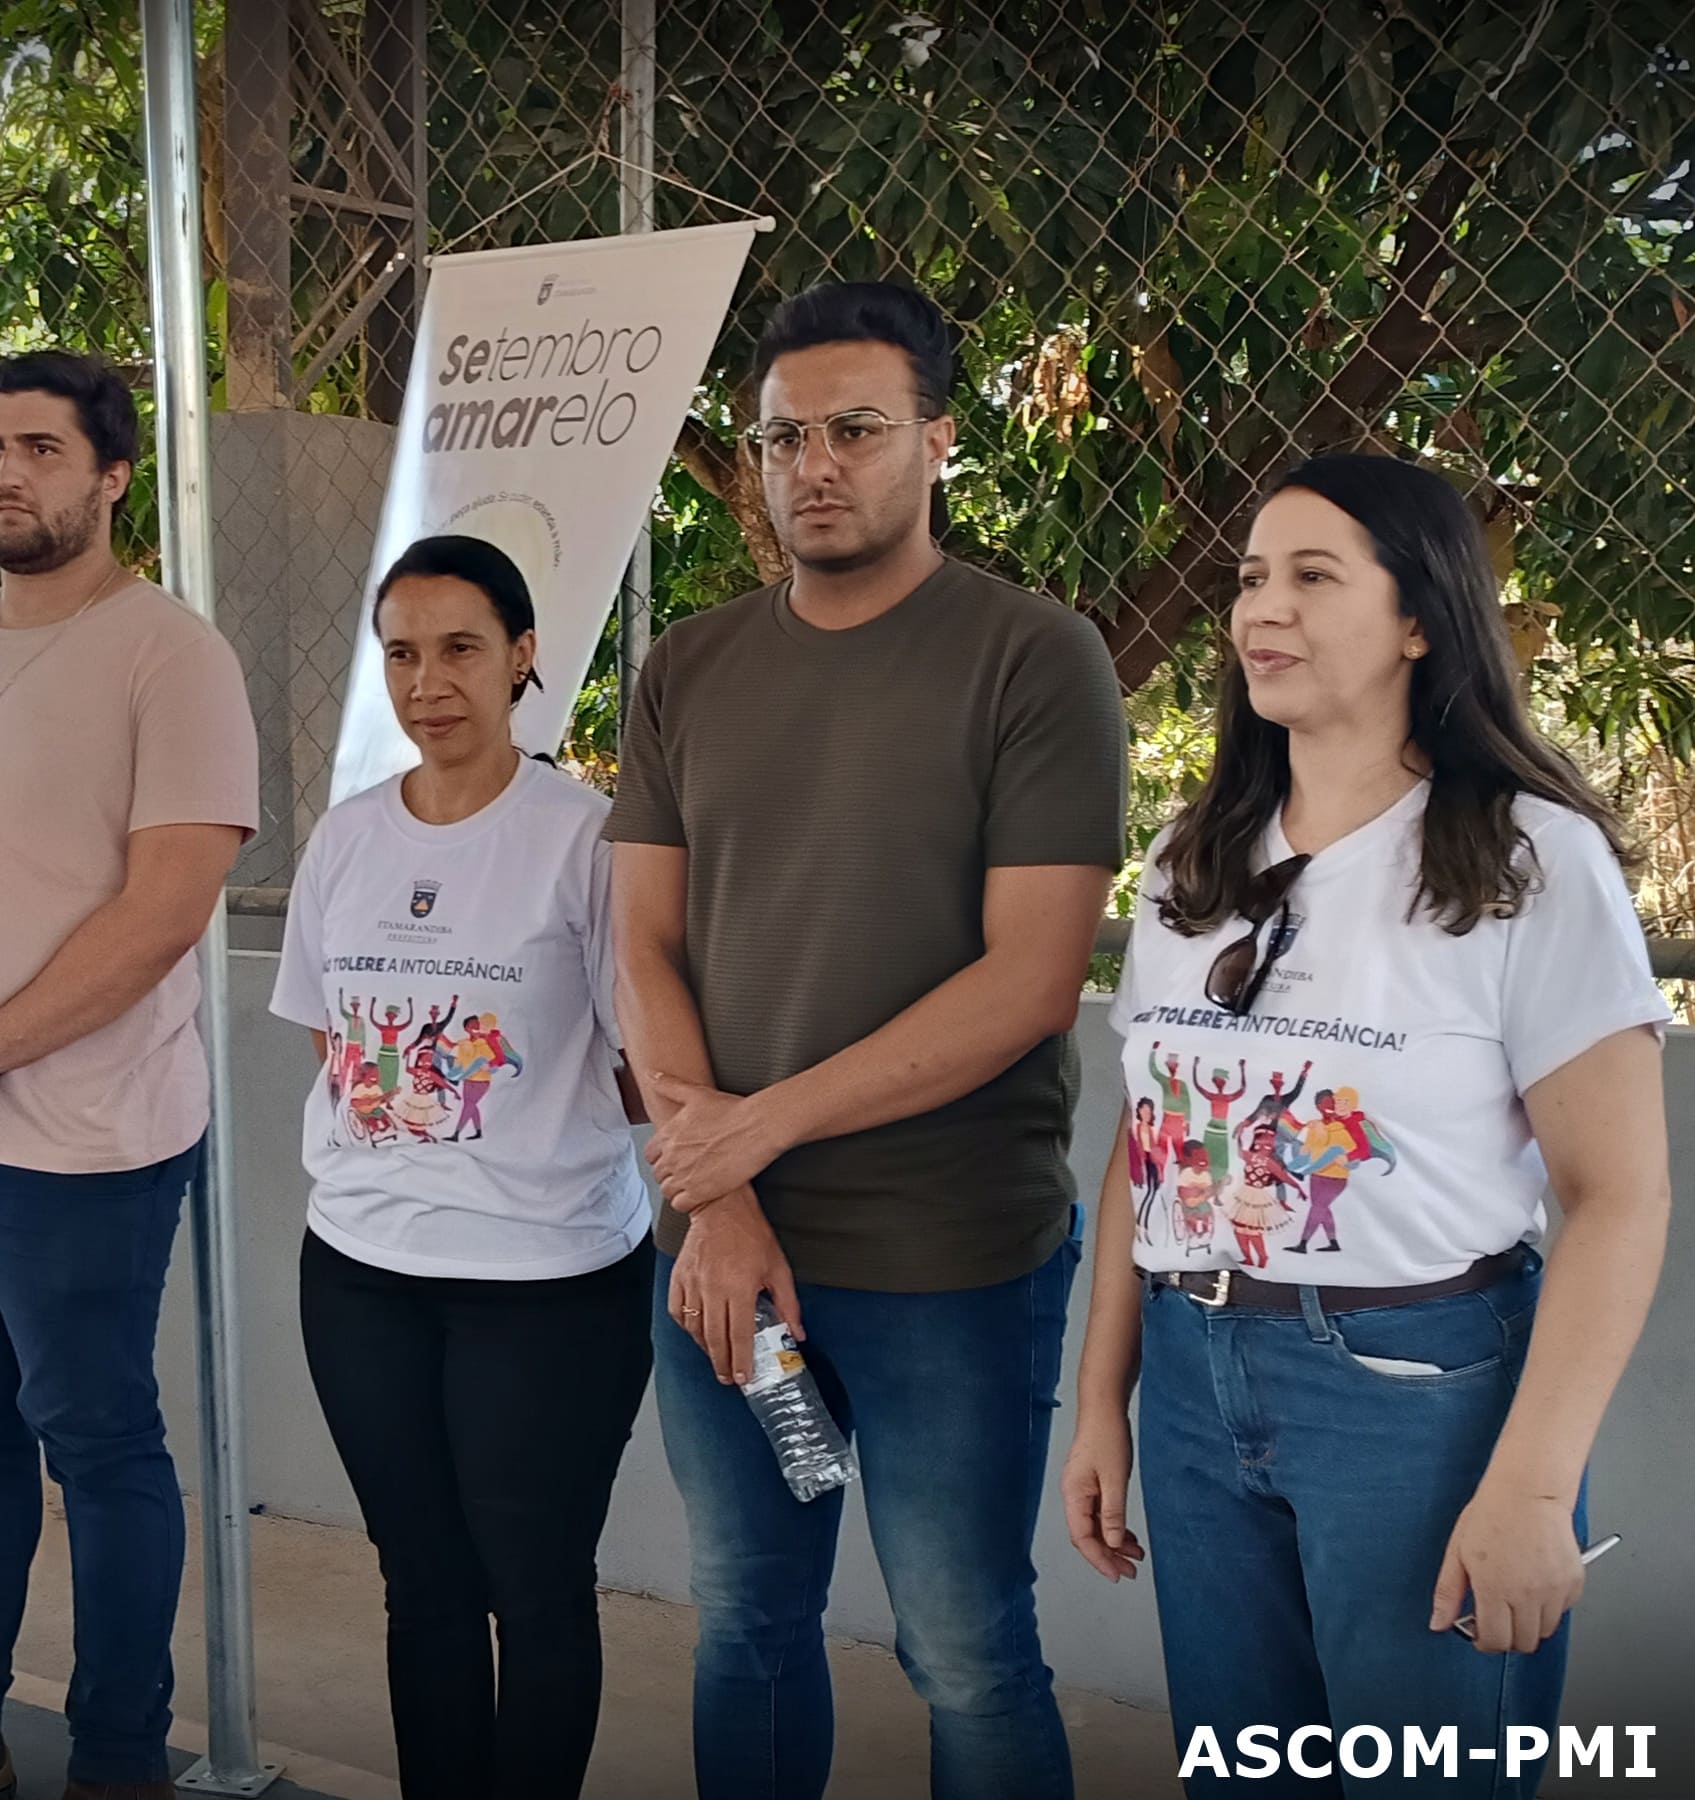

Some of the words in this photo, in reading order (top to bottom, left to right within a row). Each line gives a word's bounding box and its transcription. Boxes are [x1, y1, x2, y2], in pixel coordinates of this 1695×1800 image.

[439, 319, 662, 386] setembro
[422, 378, 636, 453] amarelo
[334, 955, 386, 973] TOLERE
[387, 957, 398, 974] A
[400, 956, 524, 984] INTOLERÂNCIA!
[1156, 1005, 1224, 1030] TOLERE
